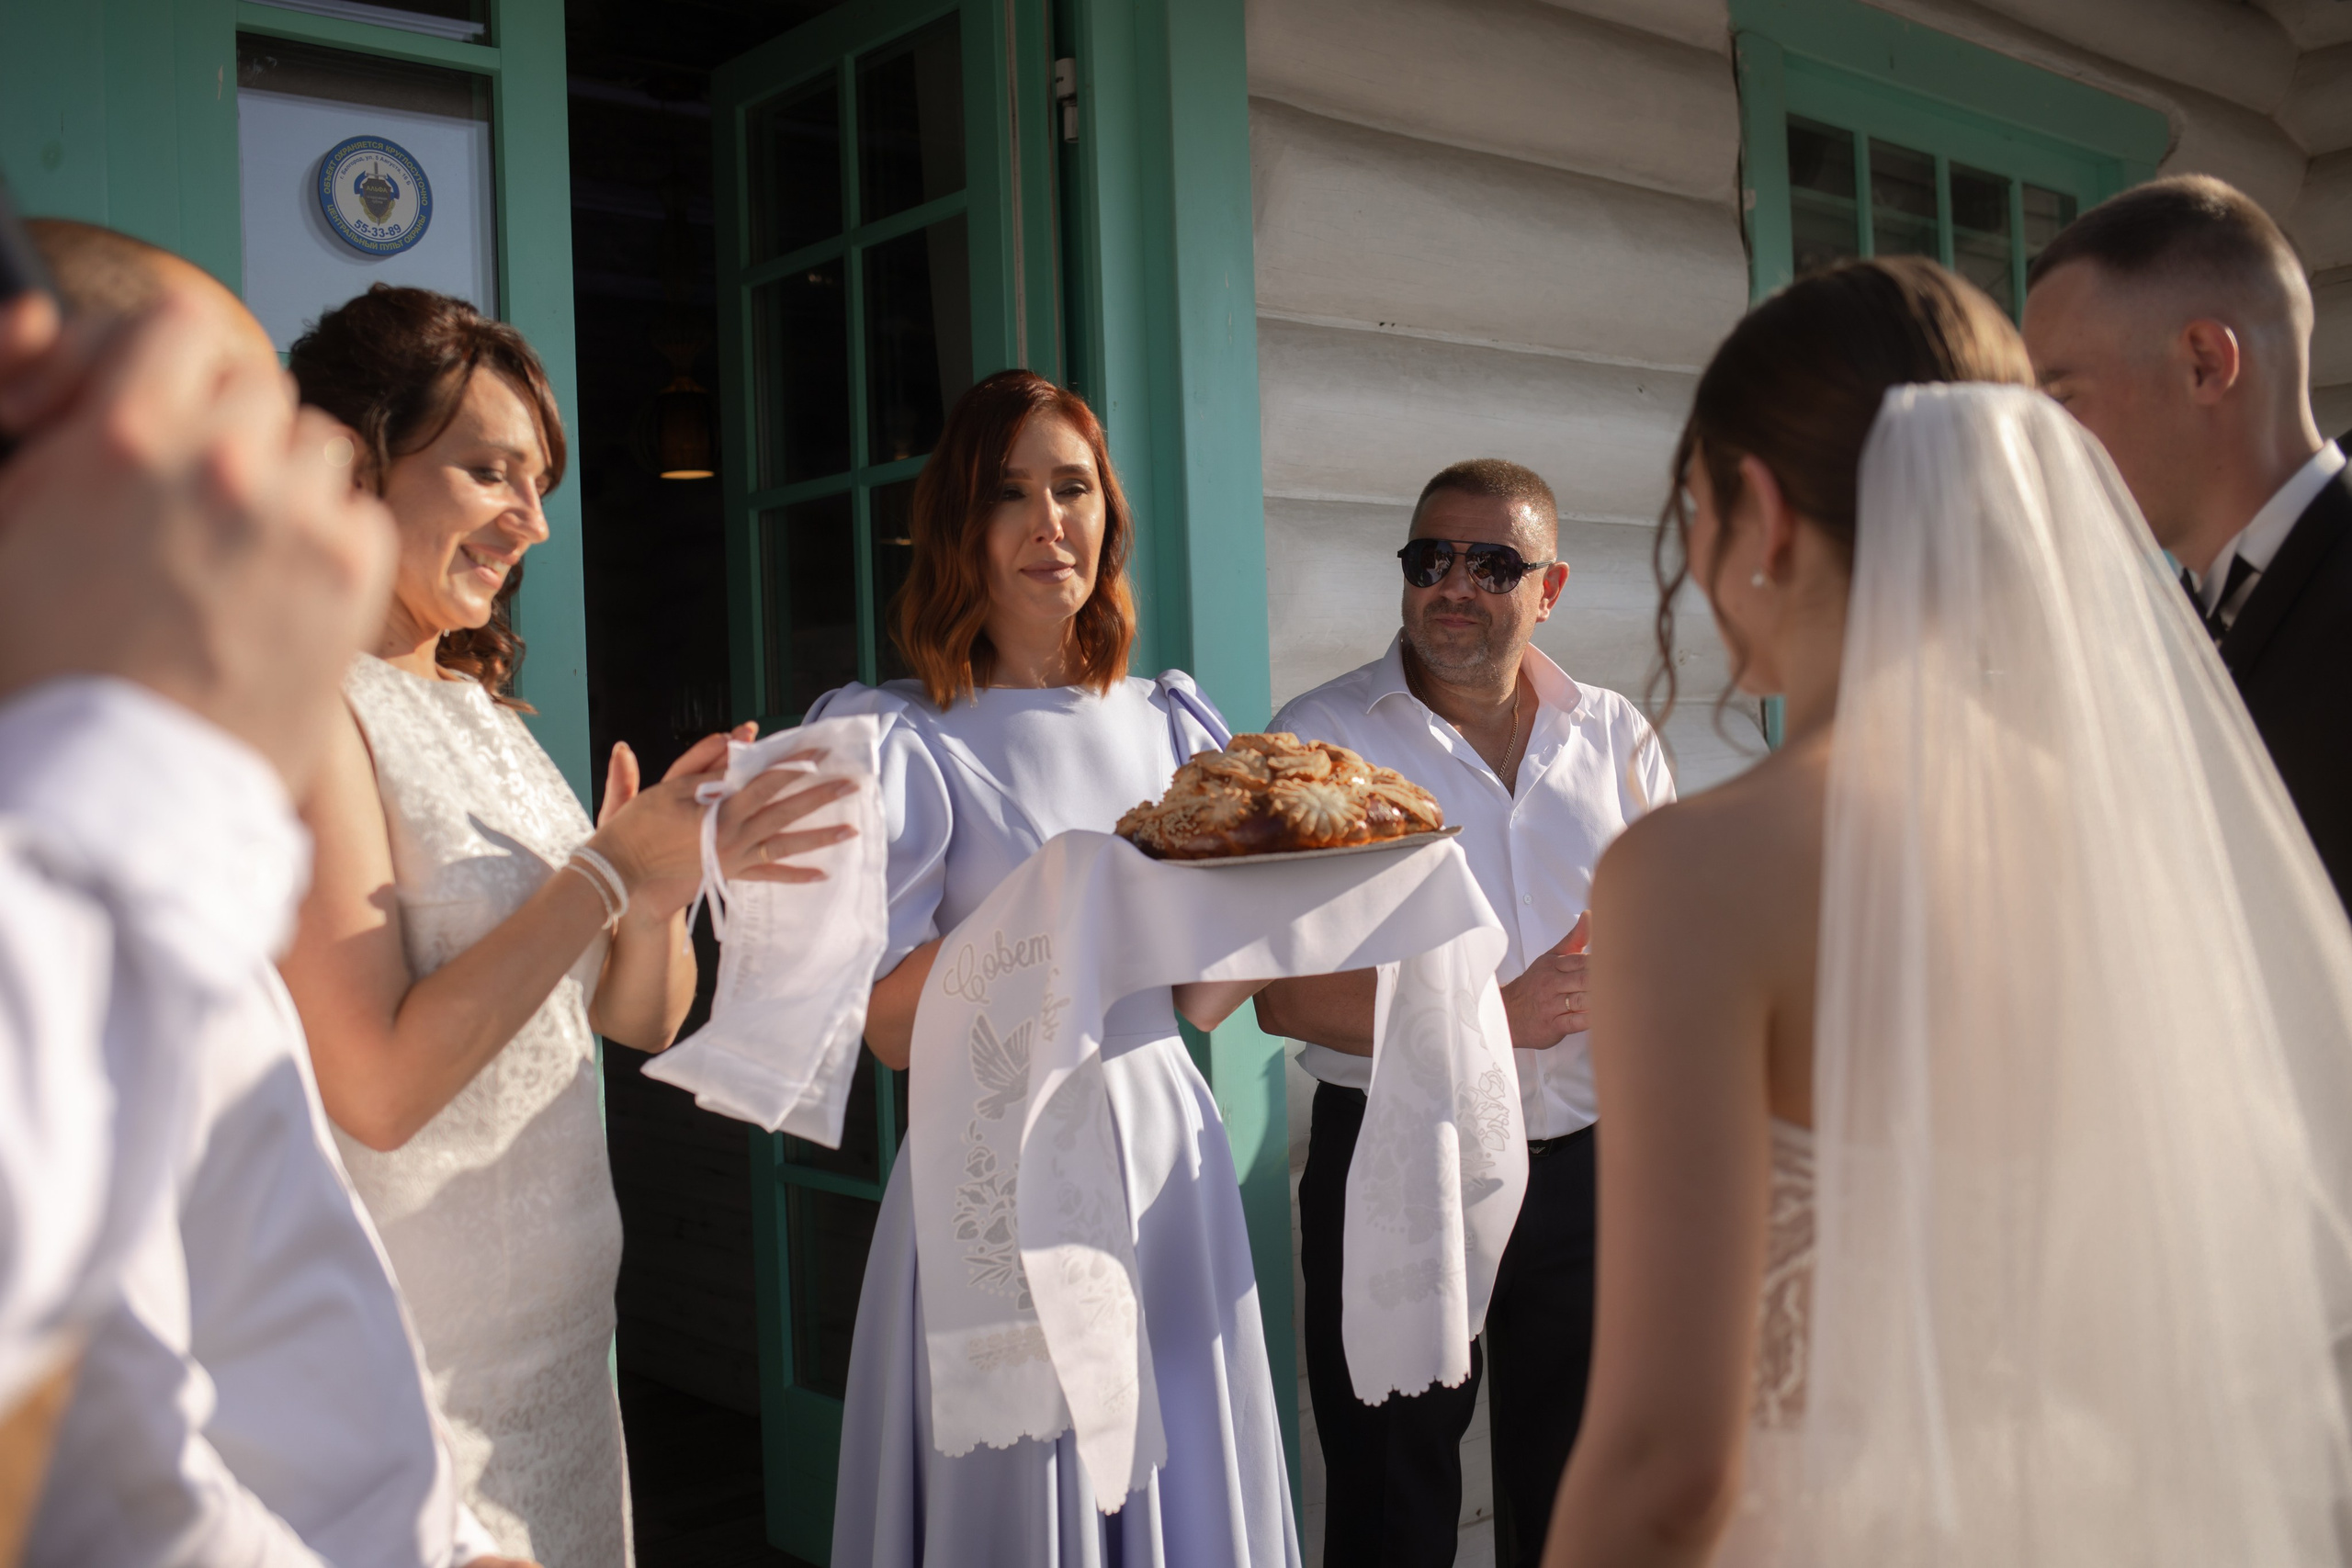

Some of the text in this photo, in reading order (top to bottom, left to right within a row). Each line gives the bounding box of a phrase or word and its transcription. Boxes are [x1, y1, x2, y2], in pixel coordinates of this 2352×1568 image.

[323, 141, 428, 206] ОБЪЕКТ ОХРАНЯЕТСЯ КРУГЛОСУТОЧНО
[327, 204, 426, 250] ЦЕНТРАЛЬНЫЙ ПУЛЬТ ОХРАНЫ
[354, 220, 401, 238] 55-33-89
